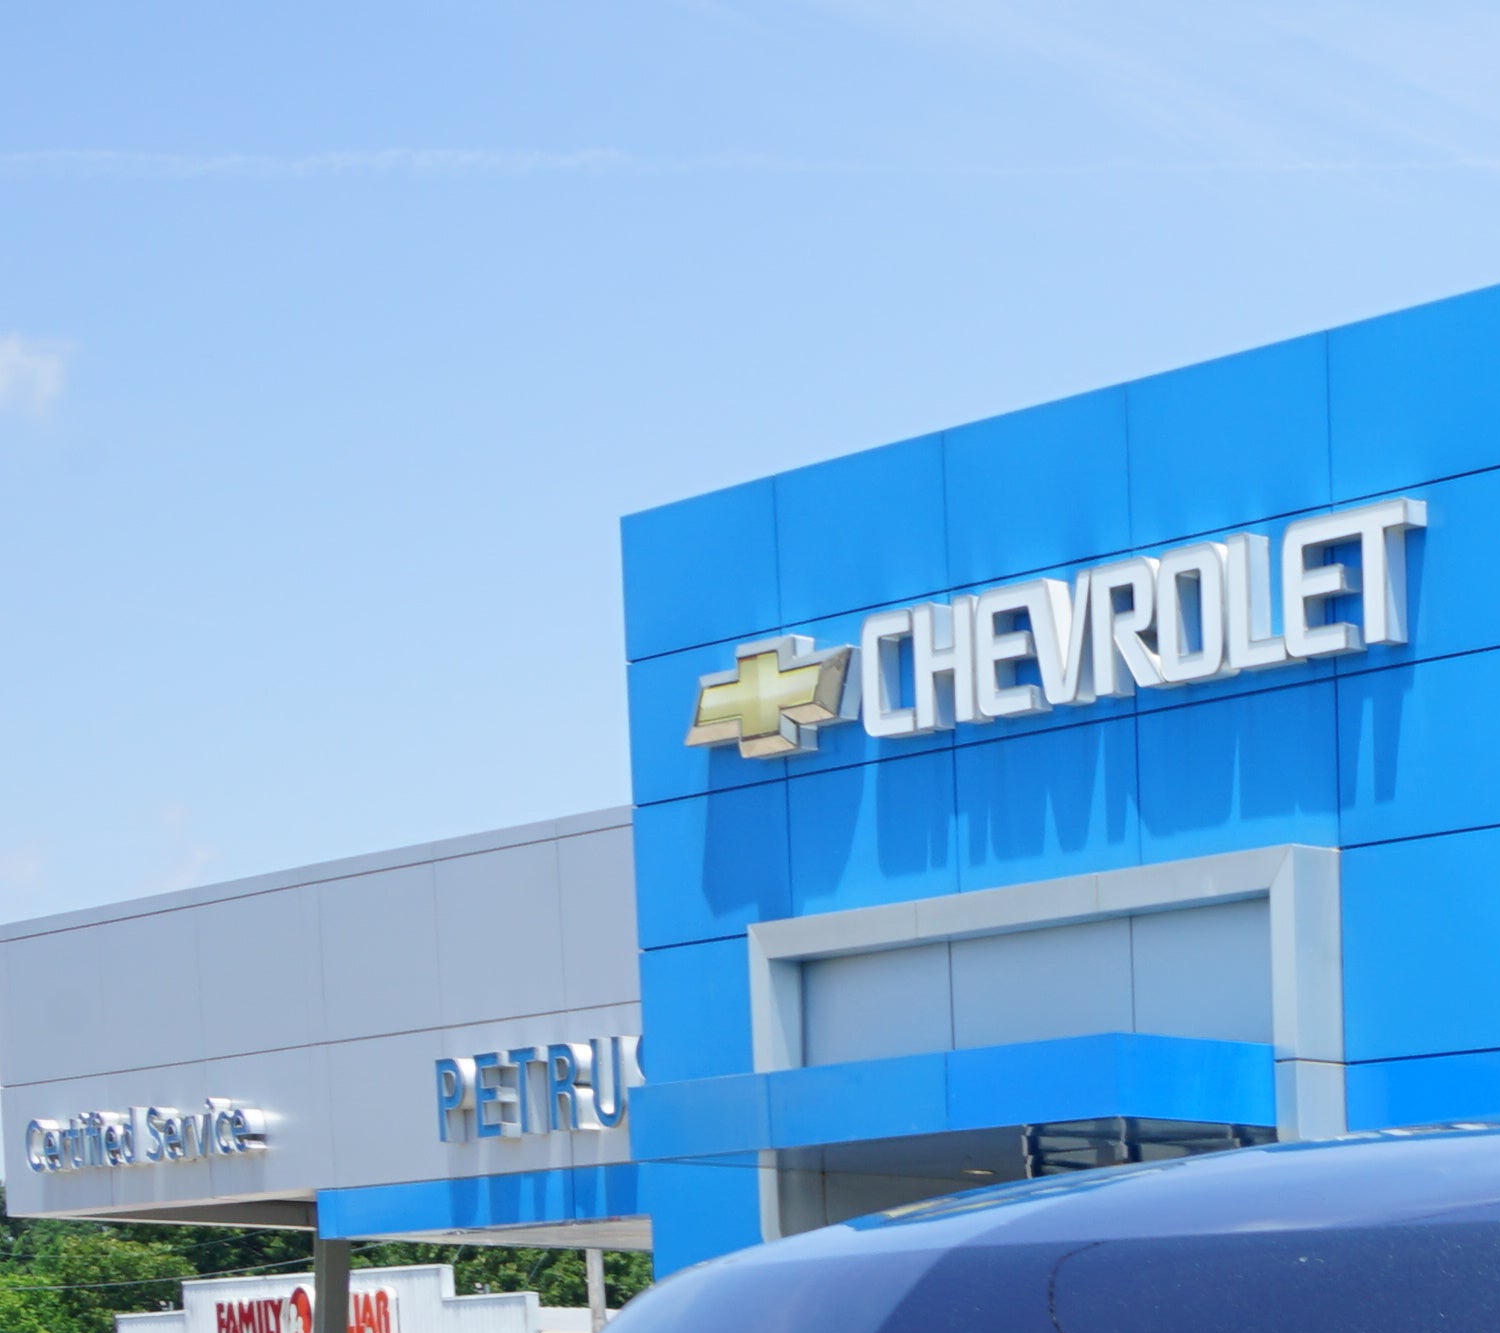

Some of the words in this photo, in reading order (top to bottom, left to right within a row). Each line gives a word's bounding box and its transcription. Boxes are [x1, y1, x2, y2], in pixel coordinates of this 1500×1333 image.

[861, 497, 1428, 738] CHEVROLET
[26, 1106, 146, 1173] Certified
[146, 1097, 268, 1162] Service
[435, 1035, 645, 1144] PETRU
